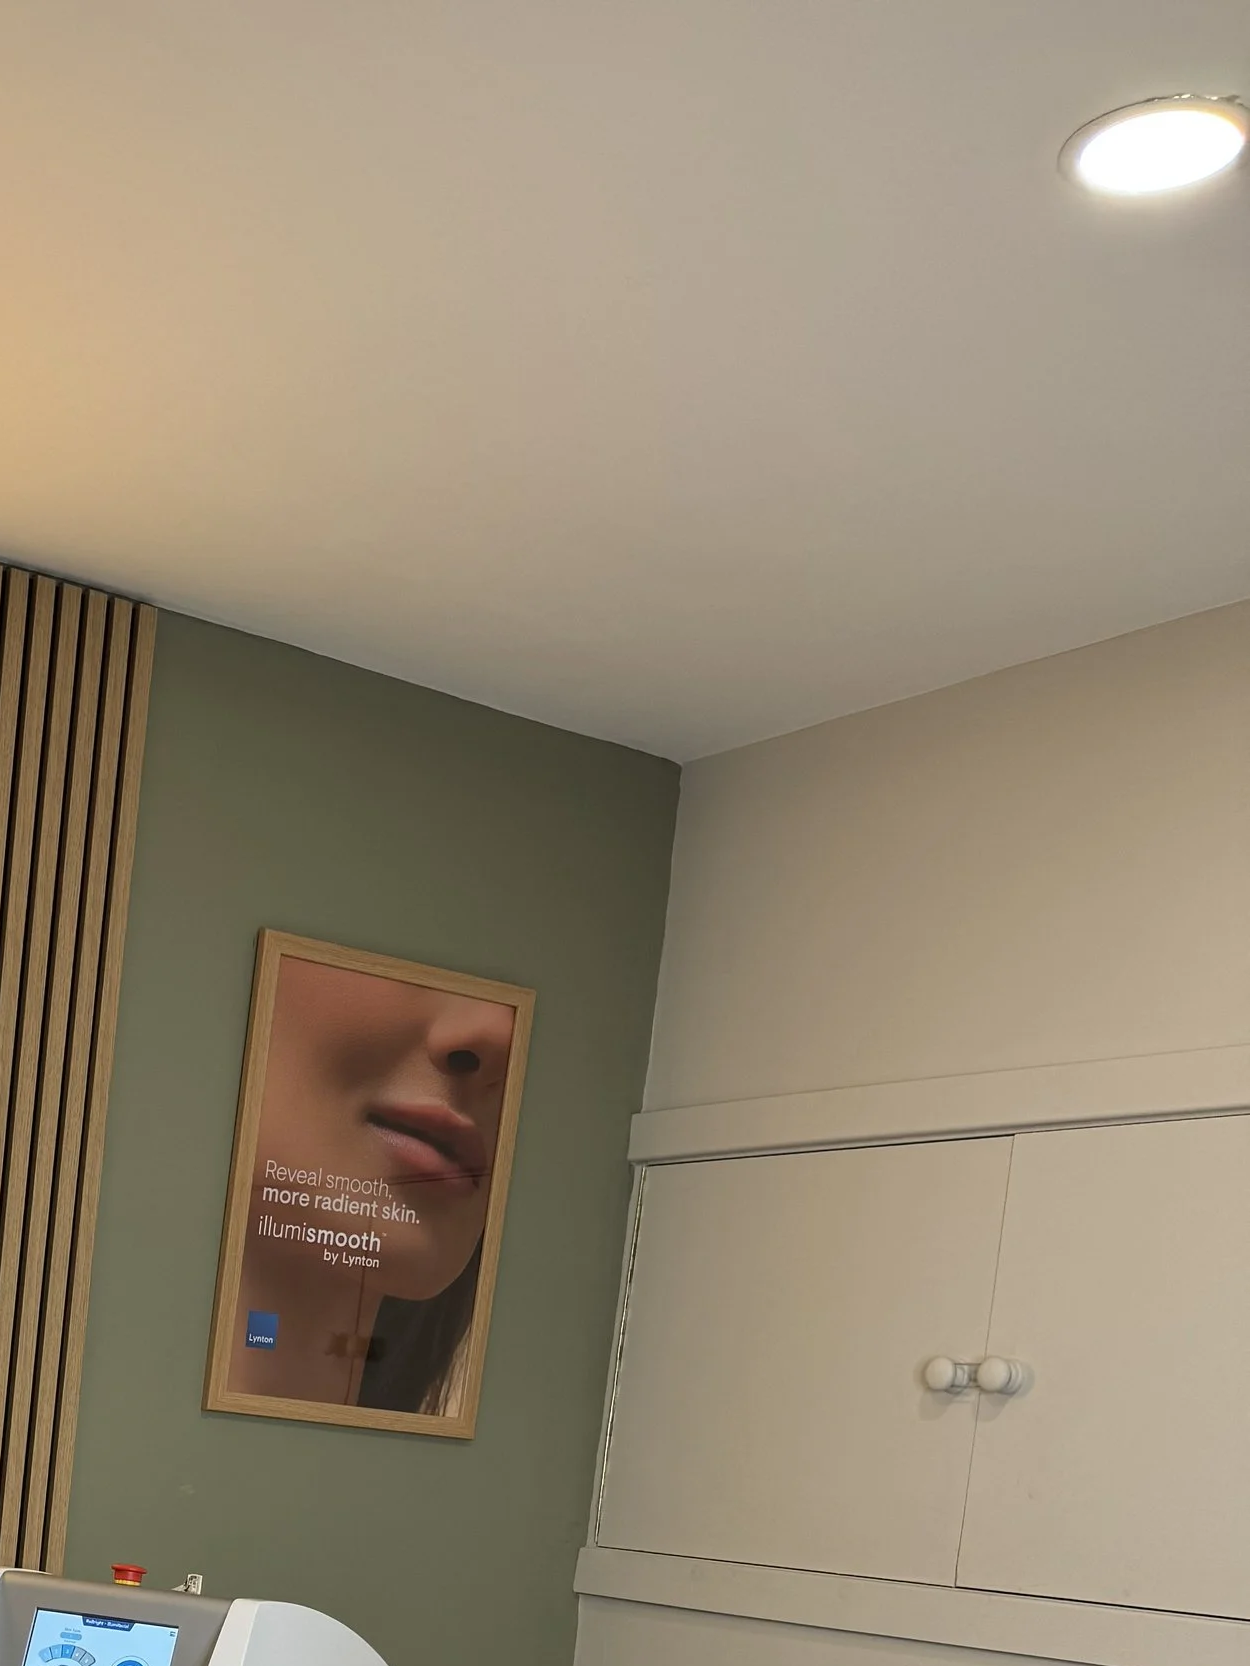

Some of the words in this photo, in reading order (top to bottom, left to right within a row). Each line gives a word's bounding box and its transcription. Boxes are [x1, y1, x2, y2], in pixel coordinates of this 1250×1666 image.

[265, 1159, 322, 1187] Reveal
[326, 1173, 392, 1200] smooth,
[262, 1186, 310, 1207] more
[314, 1193, 378, 1218] radient
[381, 1202, 420, 1224] skin.
[323, 1248, 339, 1265] by
[342, 1251, 380, 1268] Lynton
[248, 1333, 274, 1345] Lynton
